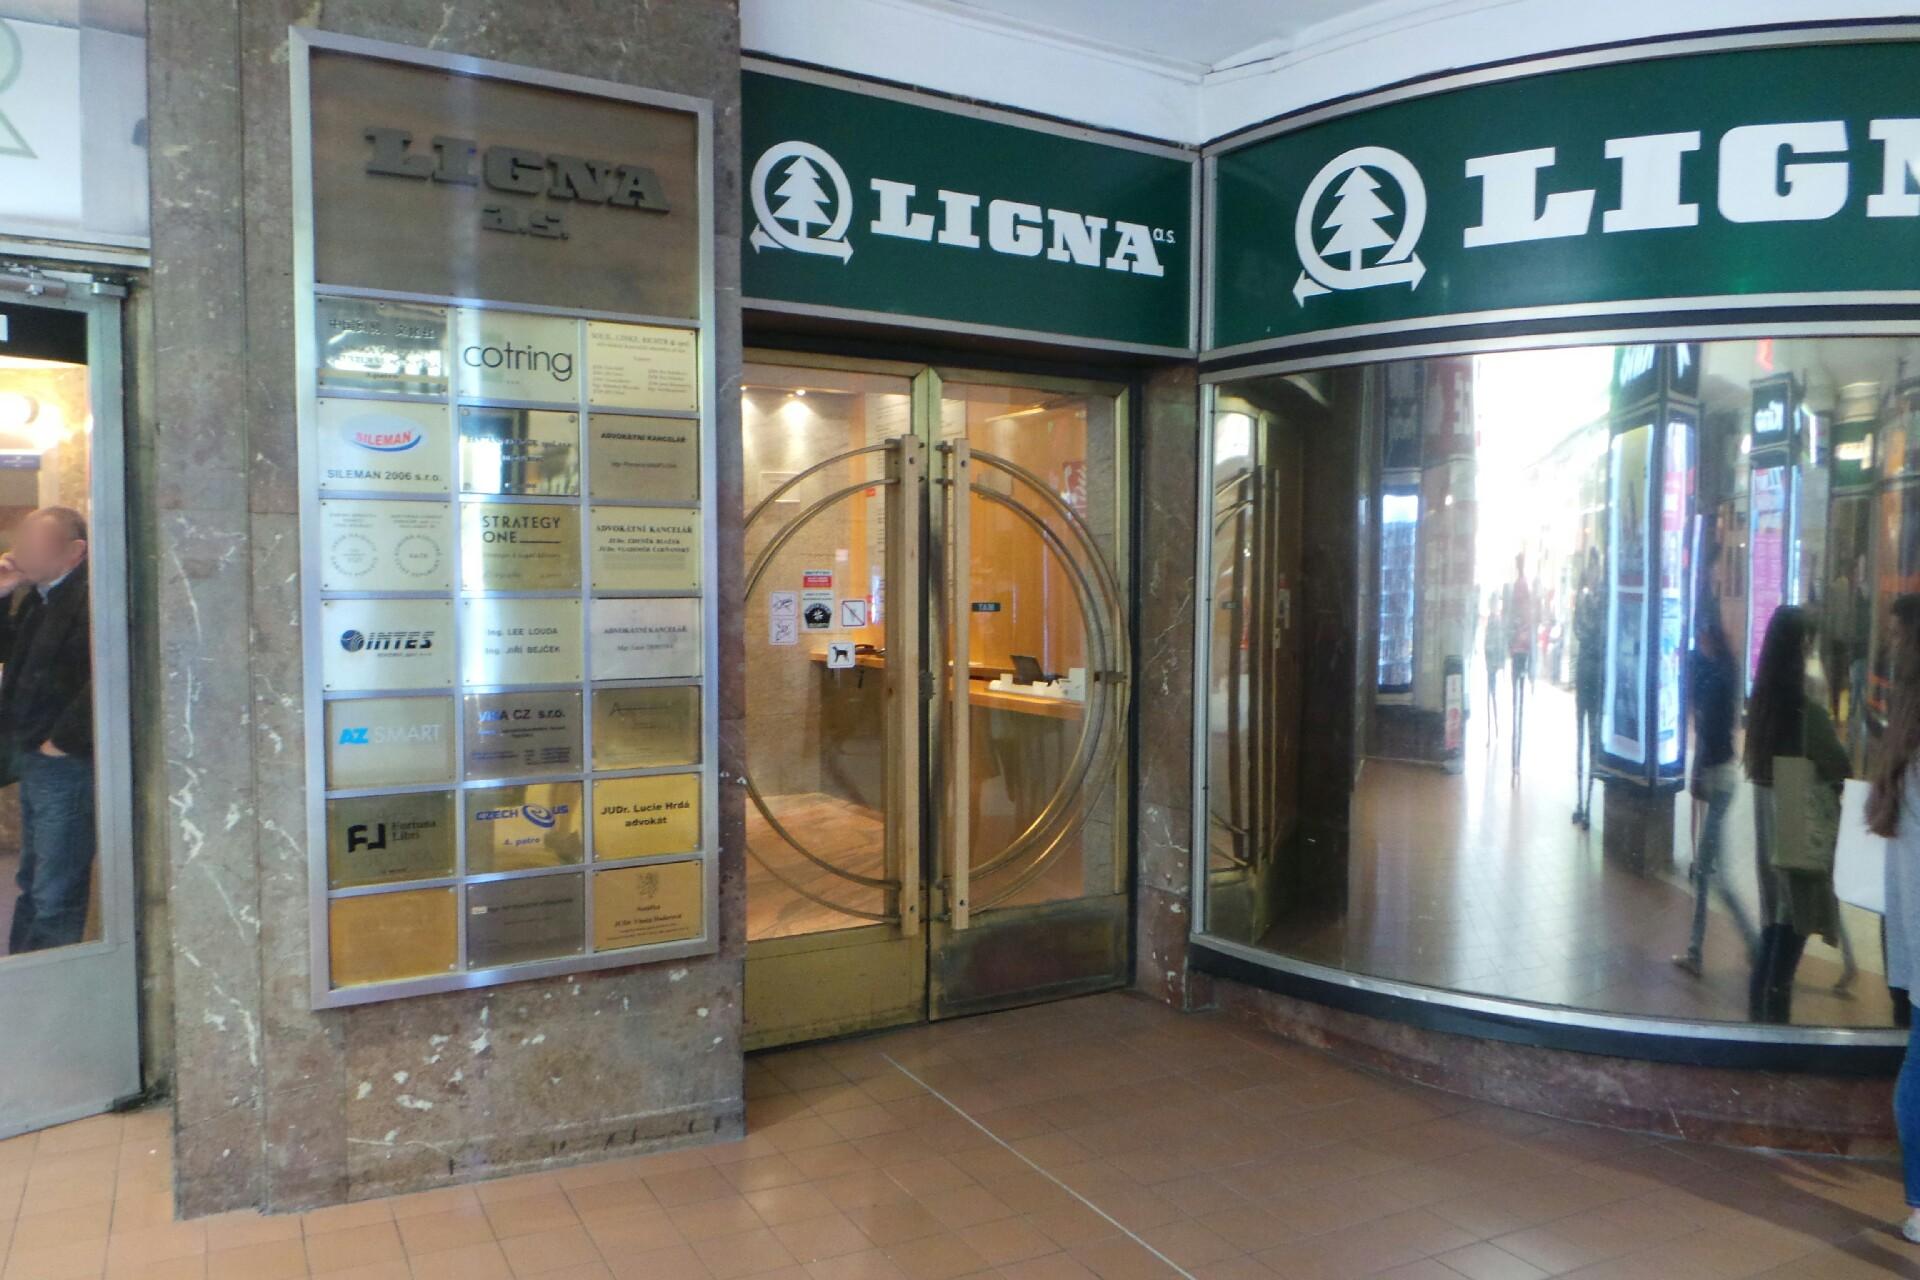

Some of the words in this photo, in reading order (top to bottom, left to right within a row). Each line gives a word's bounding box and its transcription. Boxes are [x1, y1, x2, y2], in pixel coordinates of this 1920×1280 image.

[364, 126, 671, 214] LIGNA
[870, 177, 1165, 277] LIGNA
[463, 341, 573, 382] cotring
[354, 430, 413, 446] SILEMAN
[327, 469, 381, 481] SILEMAN
[384, 471, 412, 481] 2006
[482, 515, 561, 529] STRATEGY
[482, 531, 517, 543] ONE
[513, 709, 531, 720] CZ
[338, 727, 369, 745] AZ
[373, 724, 442, 744] SMART
[475, 809, 519, 821] CZECH
[601, 805, 630, 816] JUDr.
[633, 803, 663, 813] Lucie
[515, 836, 541, 847] patro
